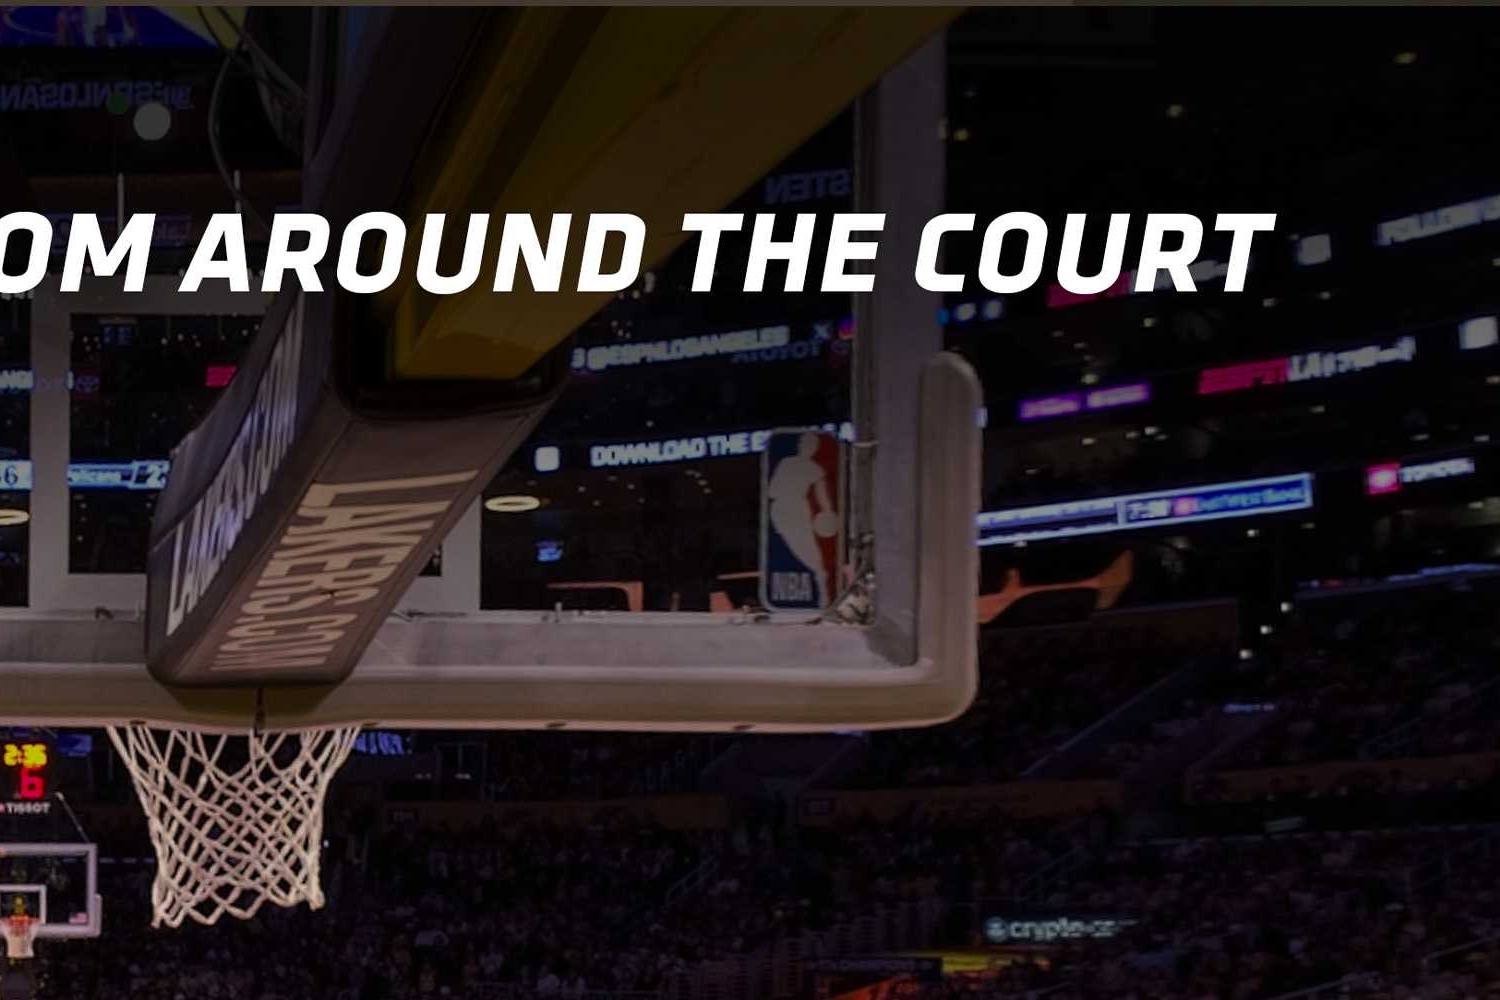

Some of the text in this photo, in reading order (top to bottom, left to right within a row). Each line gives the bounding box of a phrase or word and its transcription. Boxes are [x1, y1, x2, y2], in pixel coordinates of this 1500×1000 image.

[590, 437, 708, 467] DOWNLOAD
[707, 431, 750, 458] THE
[210, 468, 480, 672] LAKERS.COM
[6, 801, 51, 815] TISSOT
